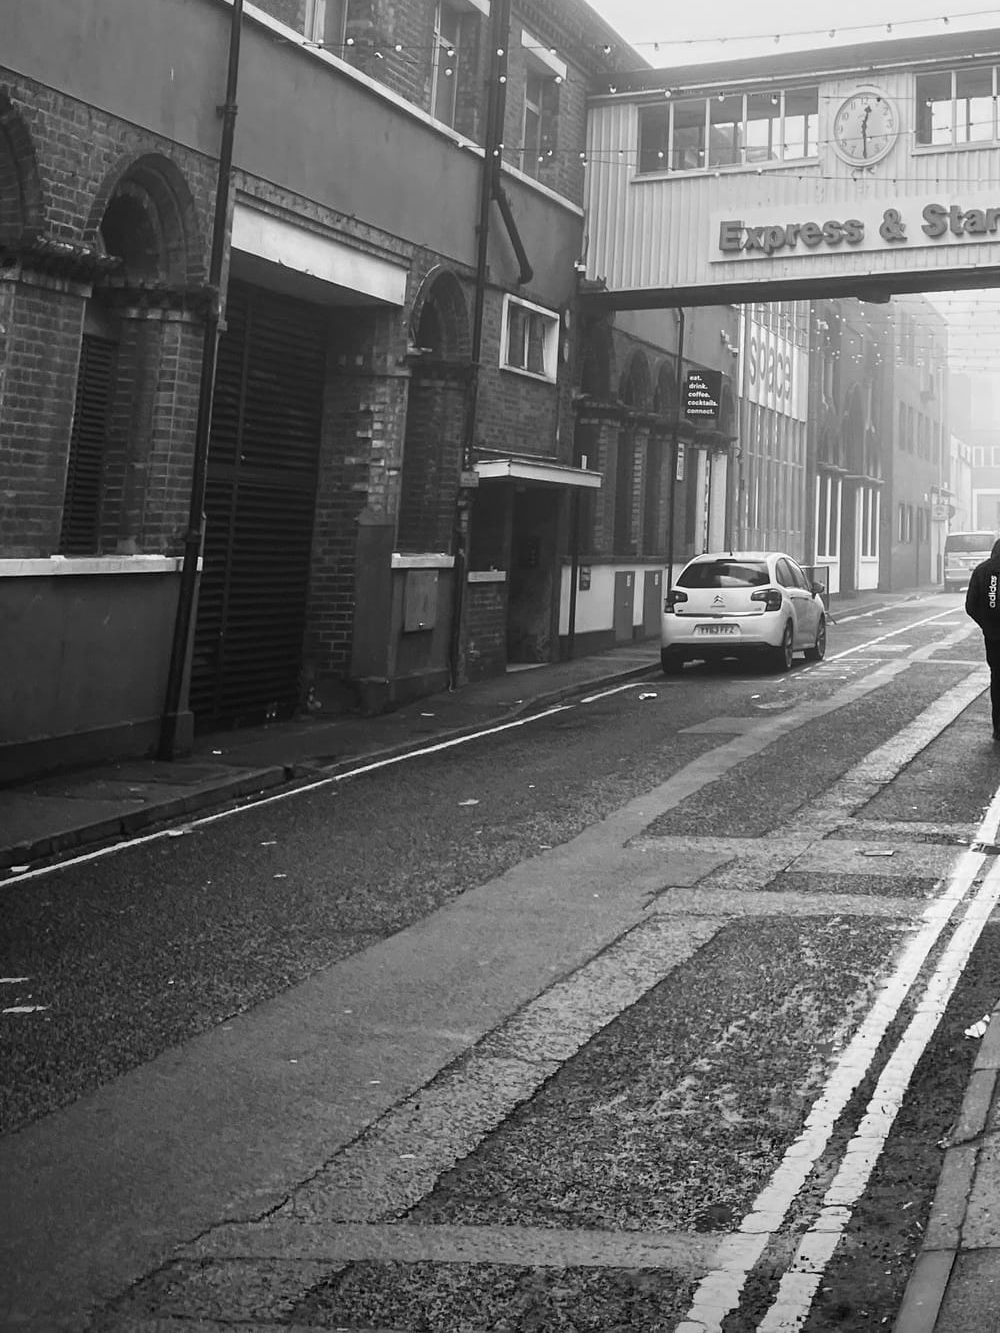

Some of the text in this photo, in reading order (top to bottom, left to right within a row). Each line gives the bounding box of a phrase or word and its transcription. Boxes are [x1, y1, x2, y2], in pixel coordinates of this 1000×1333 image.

[719, 219, 864, 256] Express
[879, 208, 908, 242] &
[689, 382, 708, 390] drink.
[749, 337, 791, 400] space
[988, 575, 998, 608] adidas
